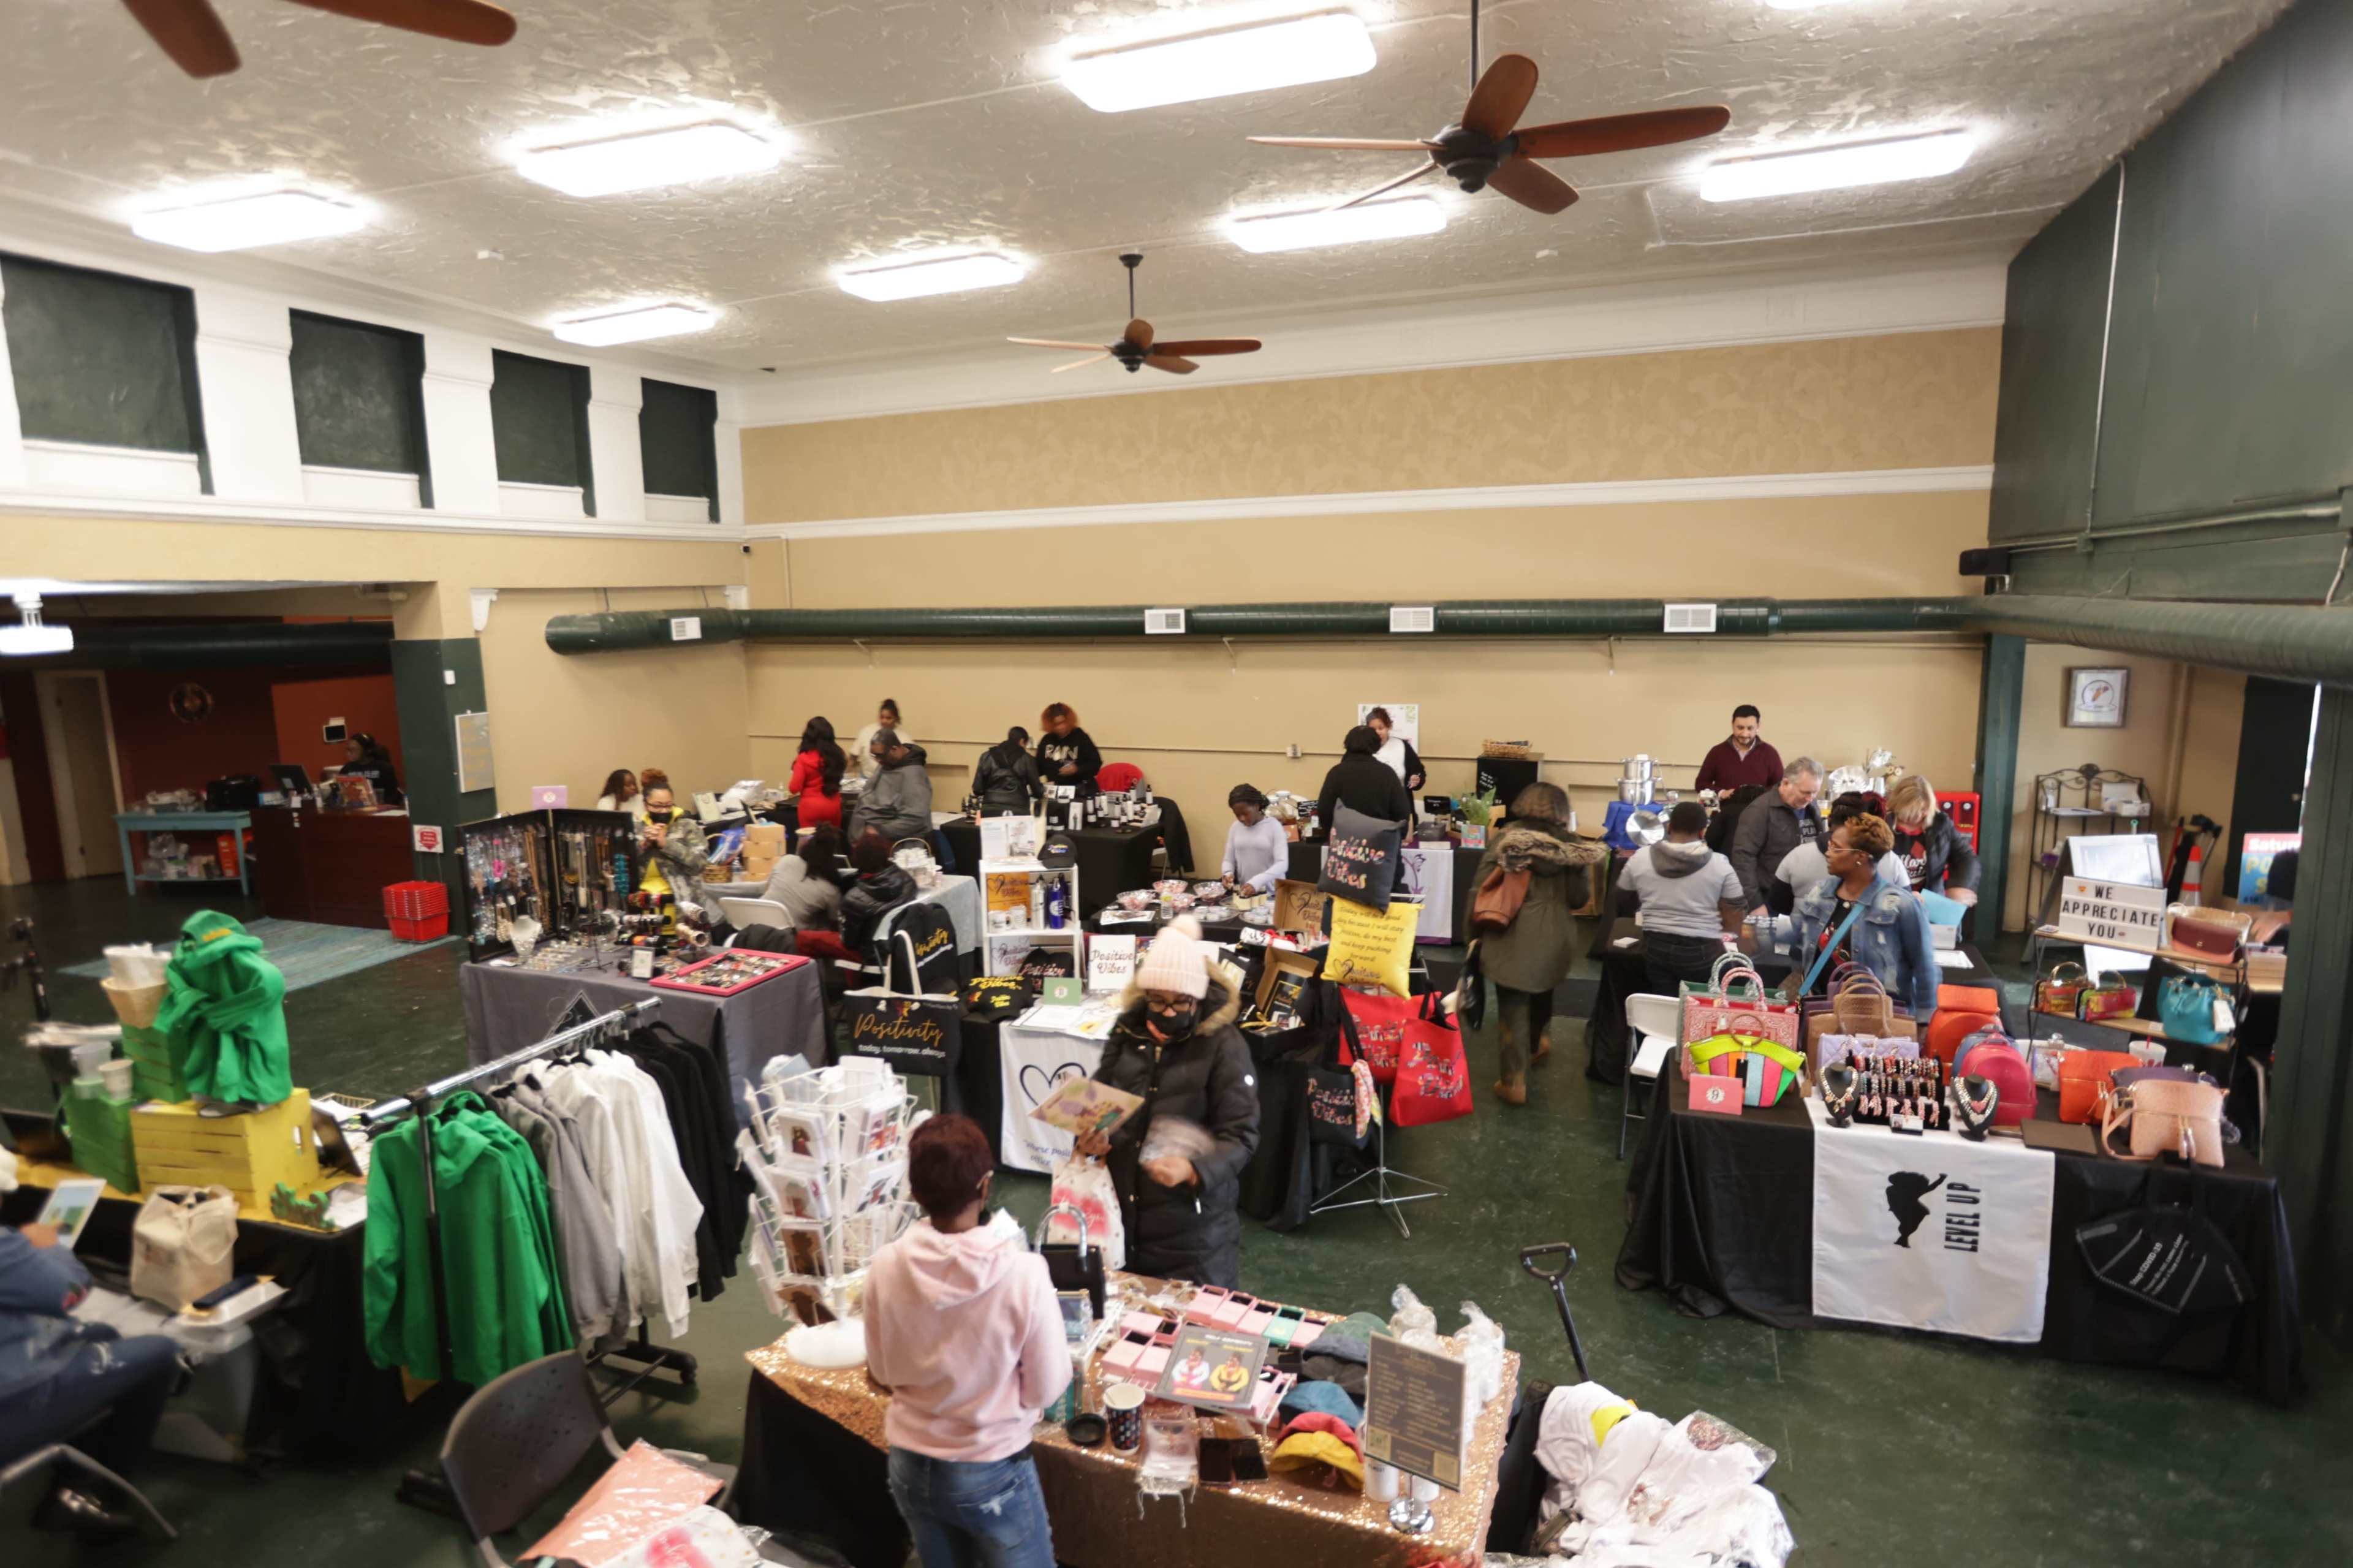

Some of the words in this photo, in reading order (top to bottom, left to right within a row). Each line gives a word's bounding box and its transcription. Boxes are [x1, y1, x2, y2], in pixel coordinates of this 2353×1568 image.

[1045, 744, 1078, 761] RAIN
[2095, 885, 2113, 900] WE
[2062, 900, 2159, 927] APPRECIATE
[2088, 922, 2115, 939] YOU
[1089, 949, 1135, 962] Positive
[1097, 962, 1127, 974] Vibes
[853, 1013, 944, 1047] Positivity
[1947, 1182, 1980, 1205] UP
[1944, 1213, 1980, 1252] LEVEL
[2140, 1242, 2162, 1273] COVID-19
